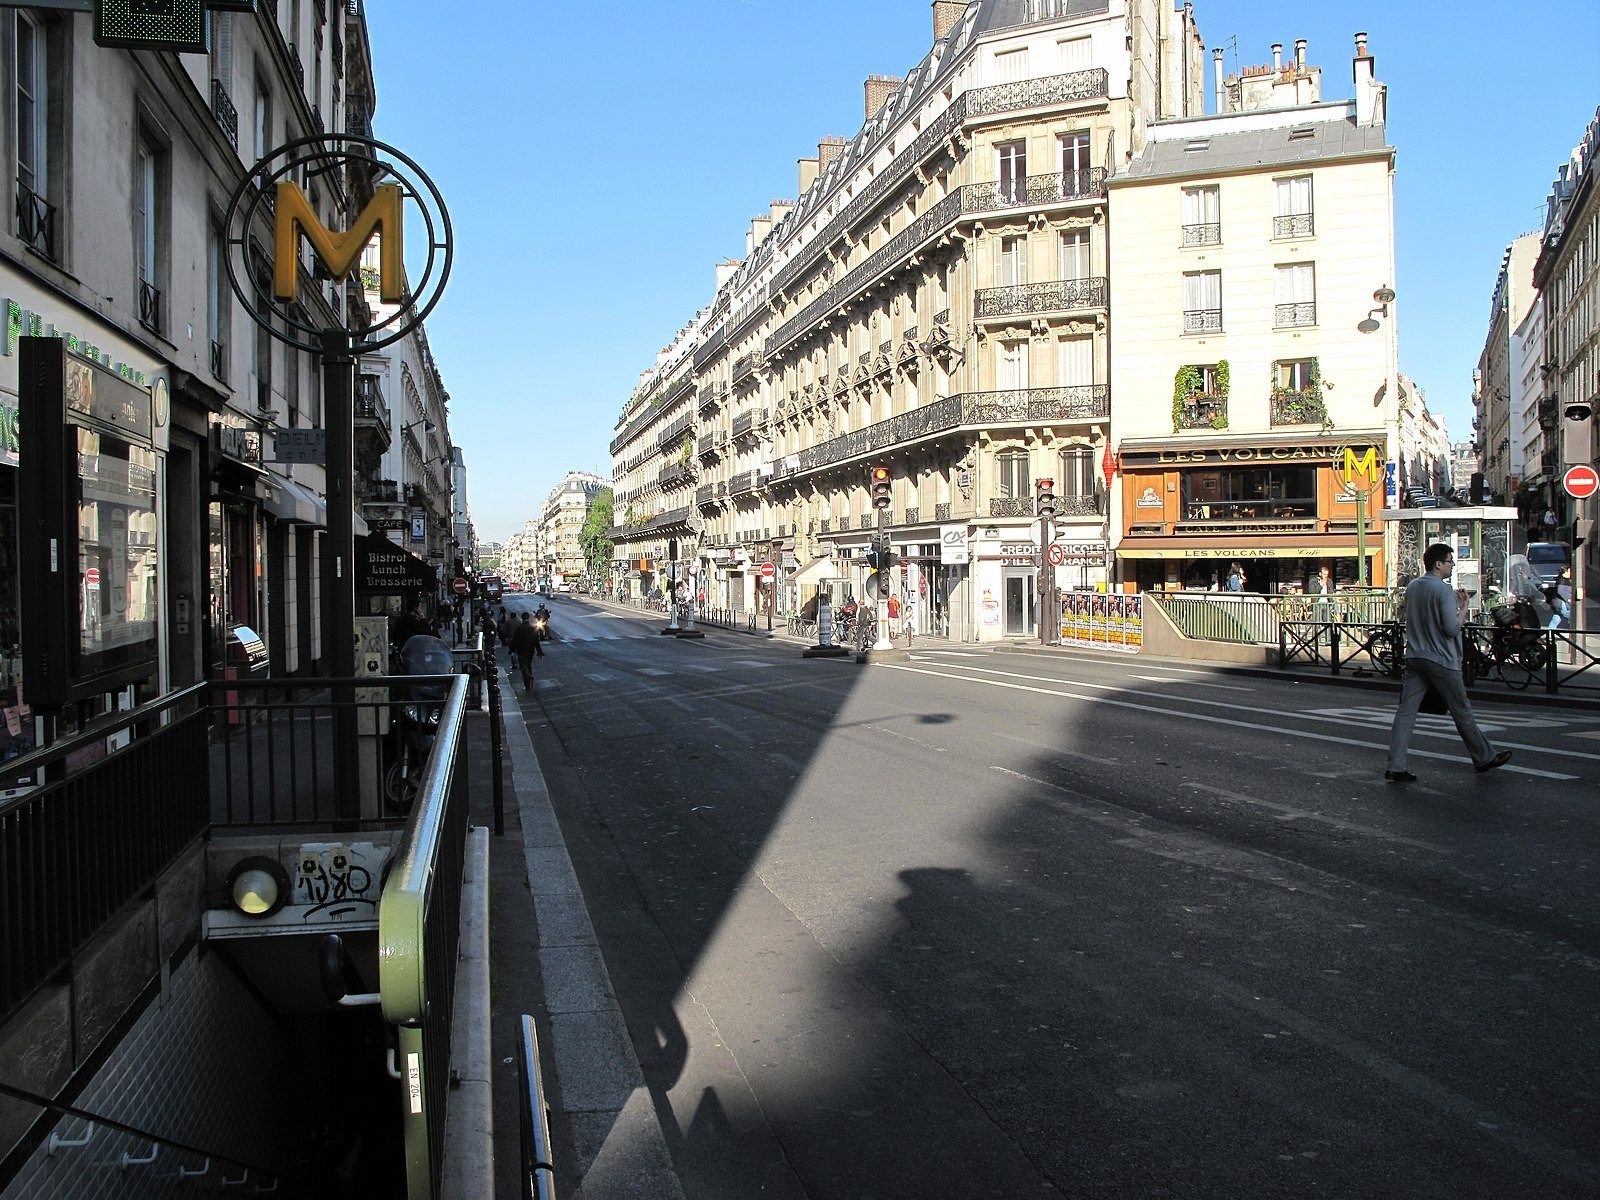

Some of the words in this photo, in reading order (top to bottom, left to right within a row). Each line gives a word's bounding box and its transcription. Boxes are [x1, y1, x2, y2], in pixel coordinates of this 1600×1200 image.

[273, 181, 403, 304] M
[1158, 449, 1206, 463] LES
[1217, 445, 1345, 461] VOLCANS
[1344, 447, 1377, 483] M
[1236, 523, 1309, 532] BRASSERIE
[1061, 545, 1104, 554] RICOLE
[368, 552, 407, 563] Bistrot
[1063, 557, 1104, 566] RANCE
[371, 565, 406, 574] Lunch
[366, 577, 423, 586] Brasserie
[409, 1067, 419, 1079] EN
[410, 1083, 420, 1098] 204
